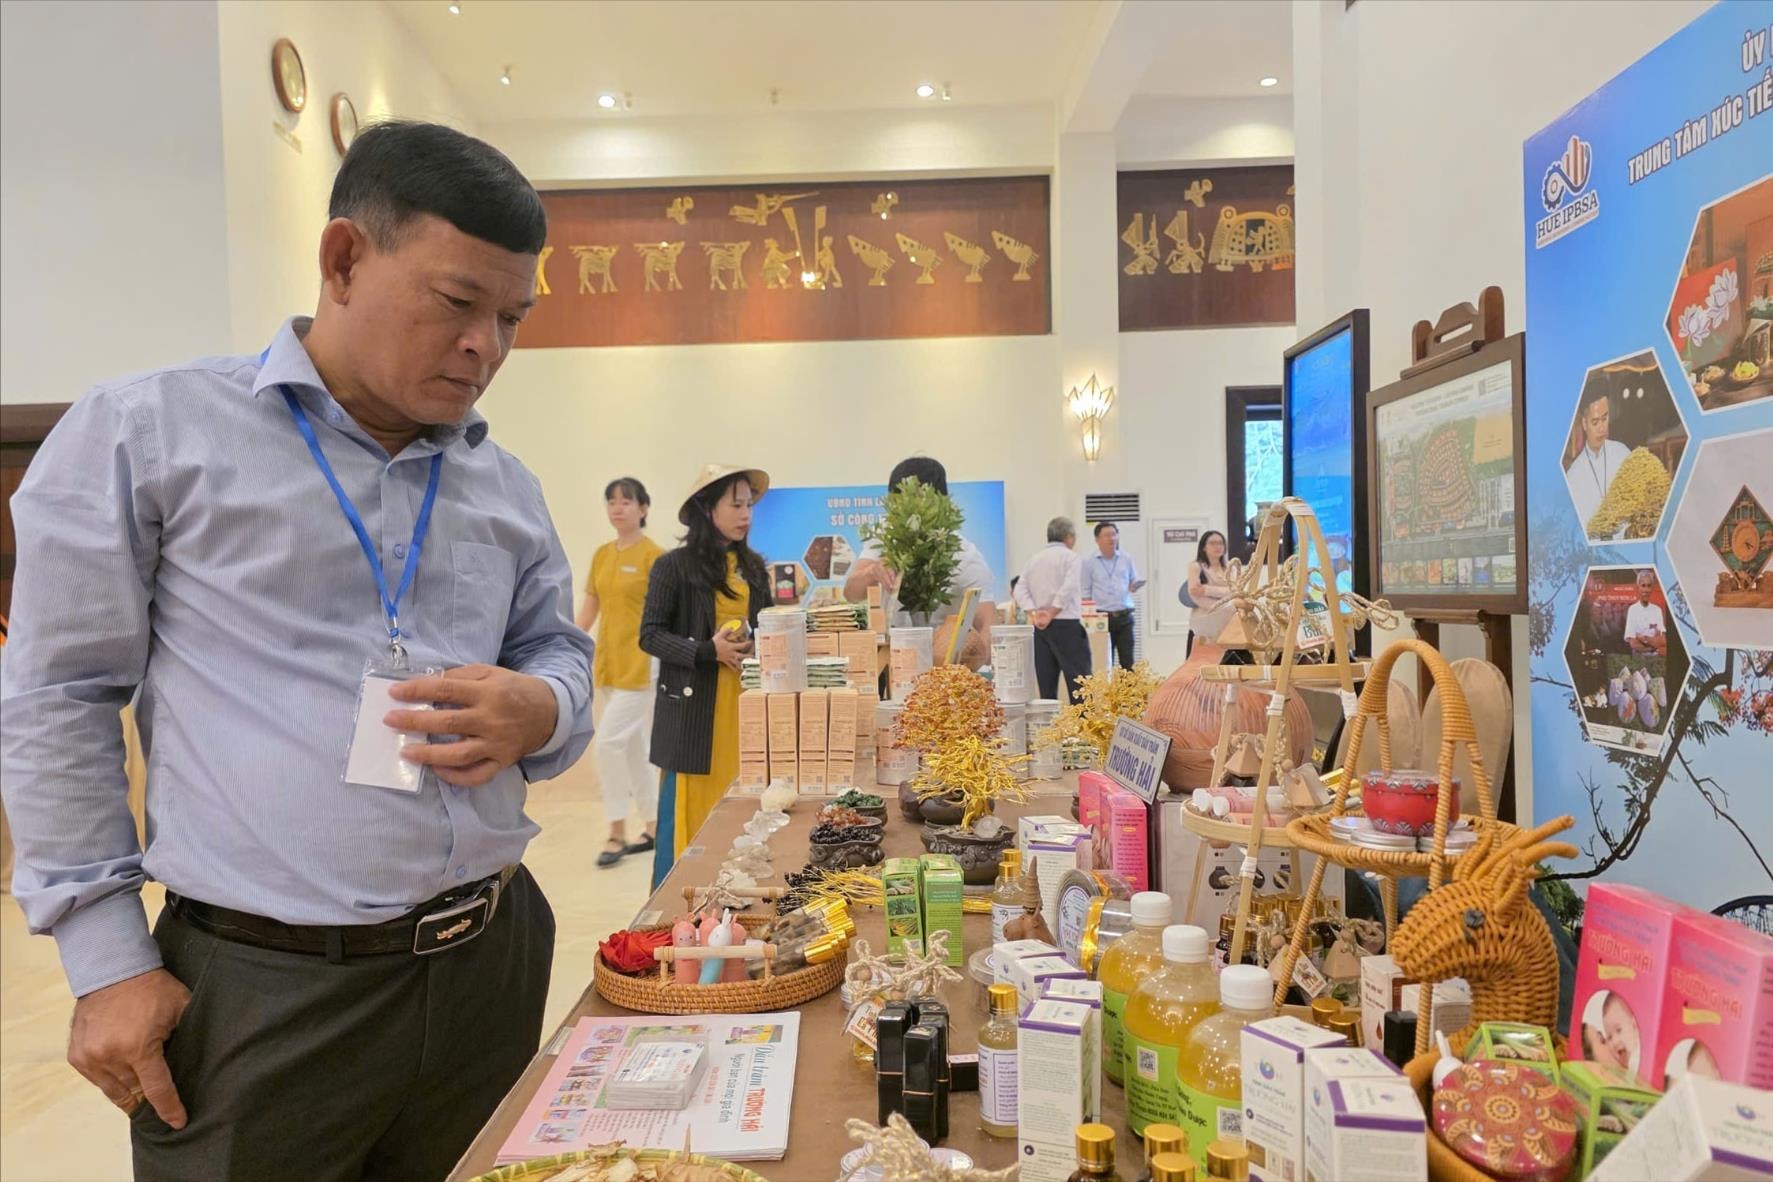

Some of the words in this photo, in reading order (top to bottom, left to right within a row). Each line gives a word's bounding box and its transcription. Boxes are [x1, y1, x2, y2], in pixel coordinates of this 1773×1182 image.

[1742, 30, 1766, 72] ỦY
[1628, 138, 1671, 185] TRUNG
[1674, 119, 1707, 159] TÂM
[1711, 94, 1744, 140] XÚC
[1537, 212, 1561, 239] HUE
[1562, 192, 1598, 226] IPBSA
[1108, 744, 1140, 783] TRƯỜNG
[1136, 757, 1156, 792] HẢI
[744, 1088, 766, 1117] TRƯỜNG
